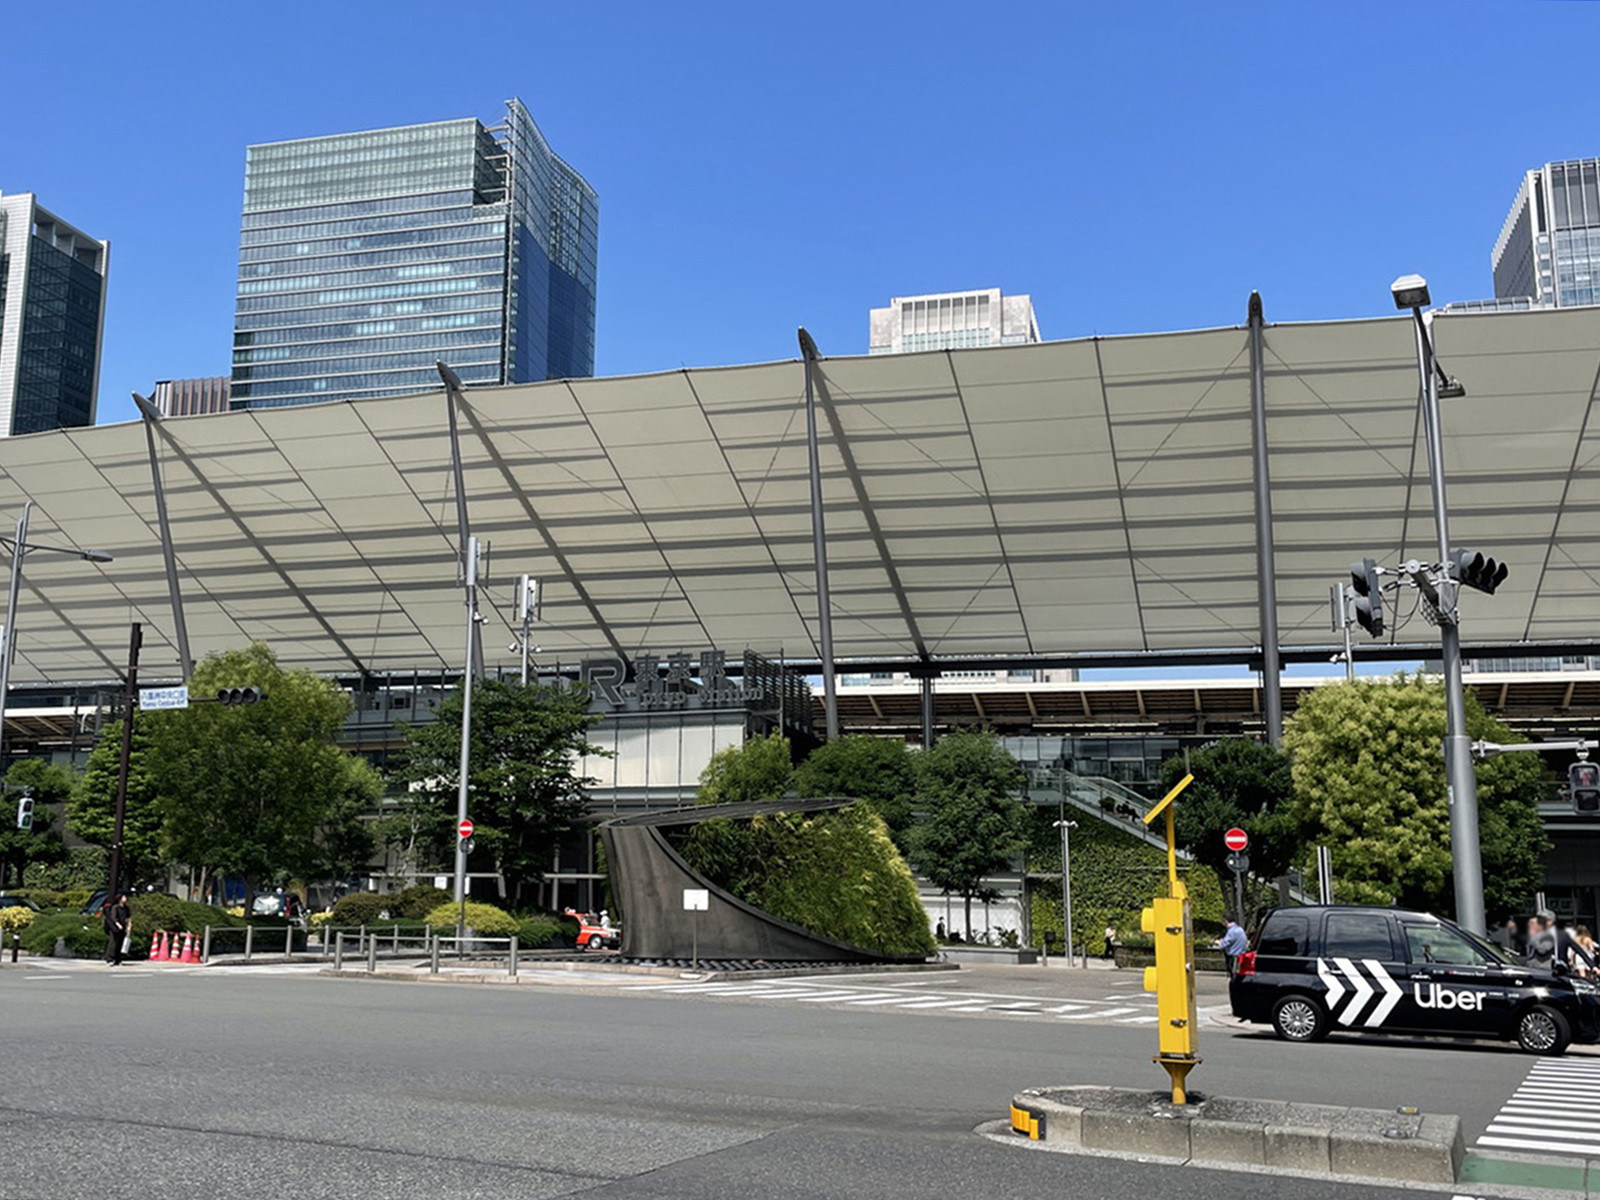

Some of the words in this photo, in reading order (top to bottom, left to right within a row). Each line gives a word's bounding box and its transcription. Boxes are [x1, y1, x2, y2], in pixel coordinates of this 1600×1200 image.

[633, 650, 726, 681] 東京駅
[1414, 982, 1487, 1011] Uber
